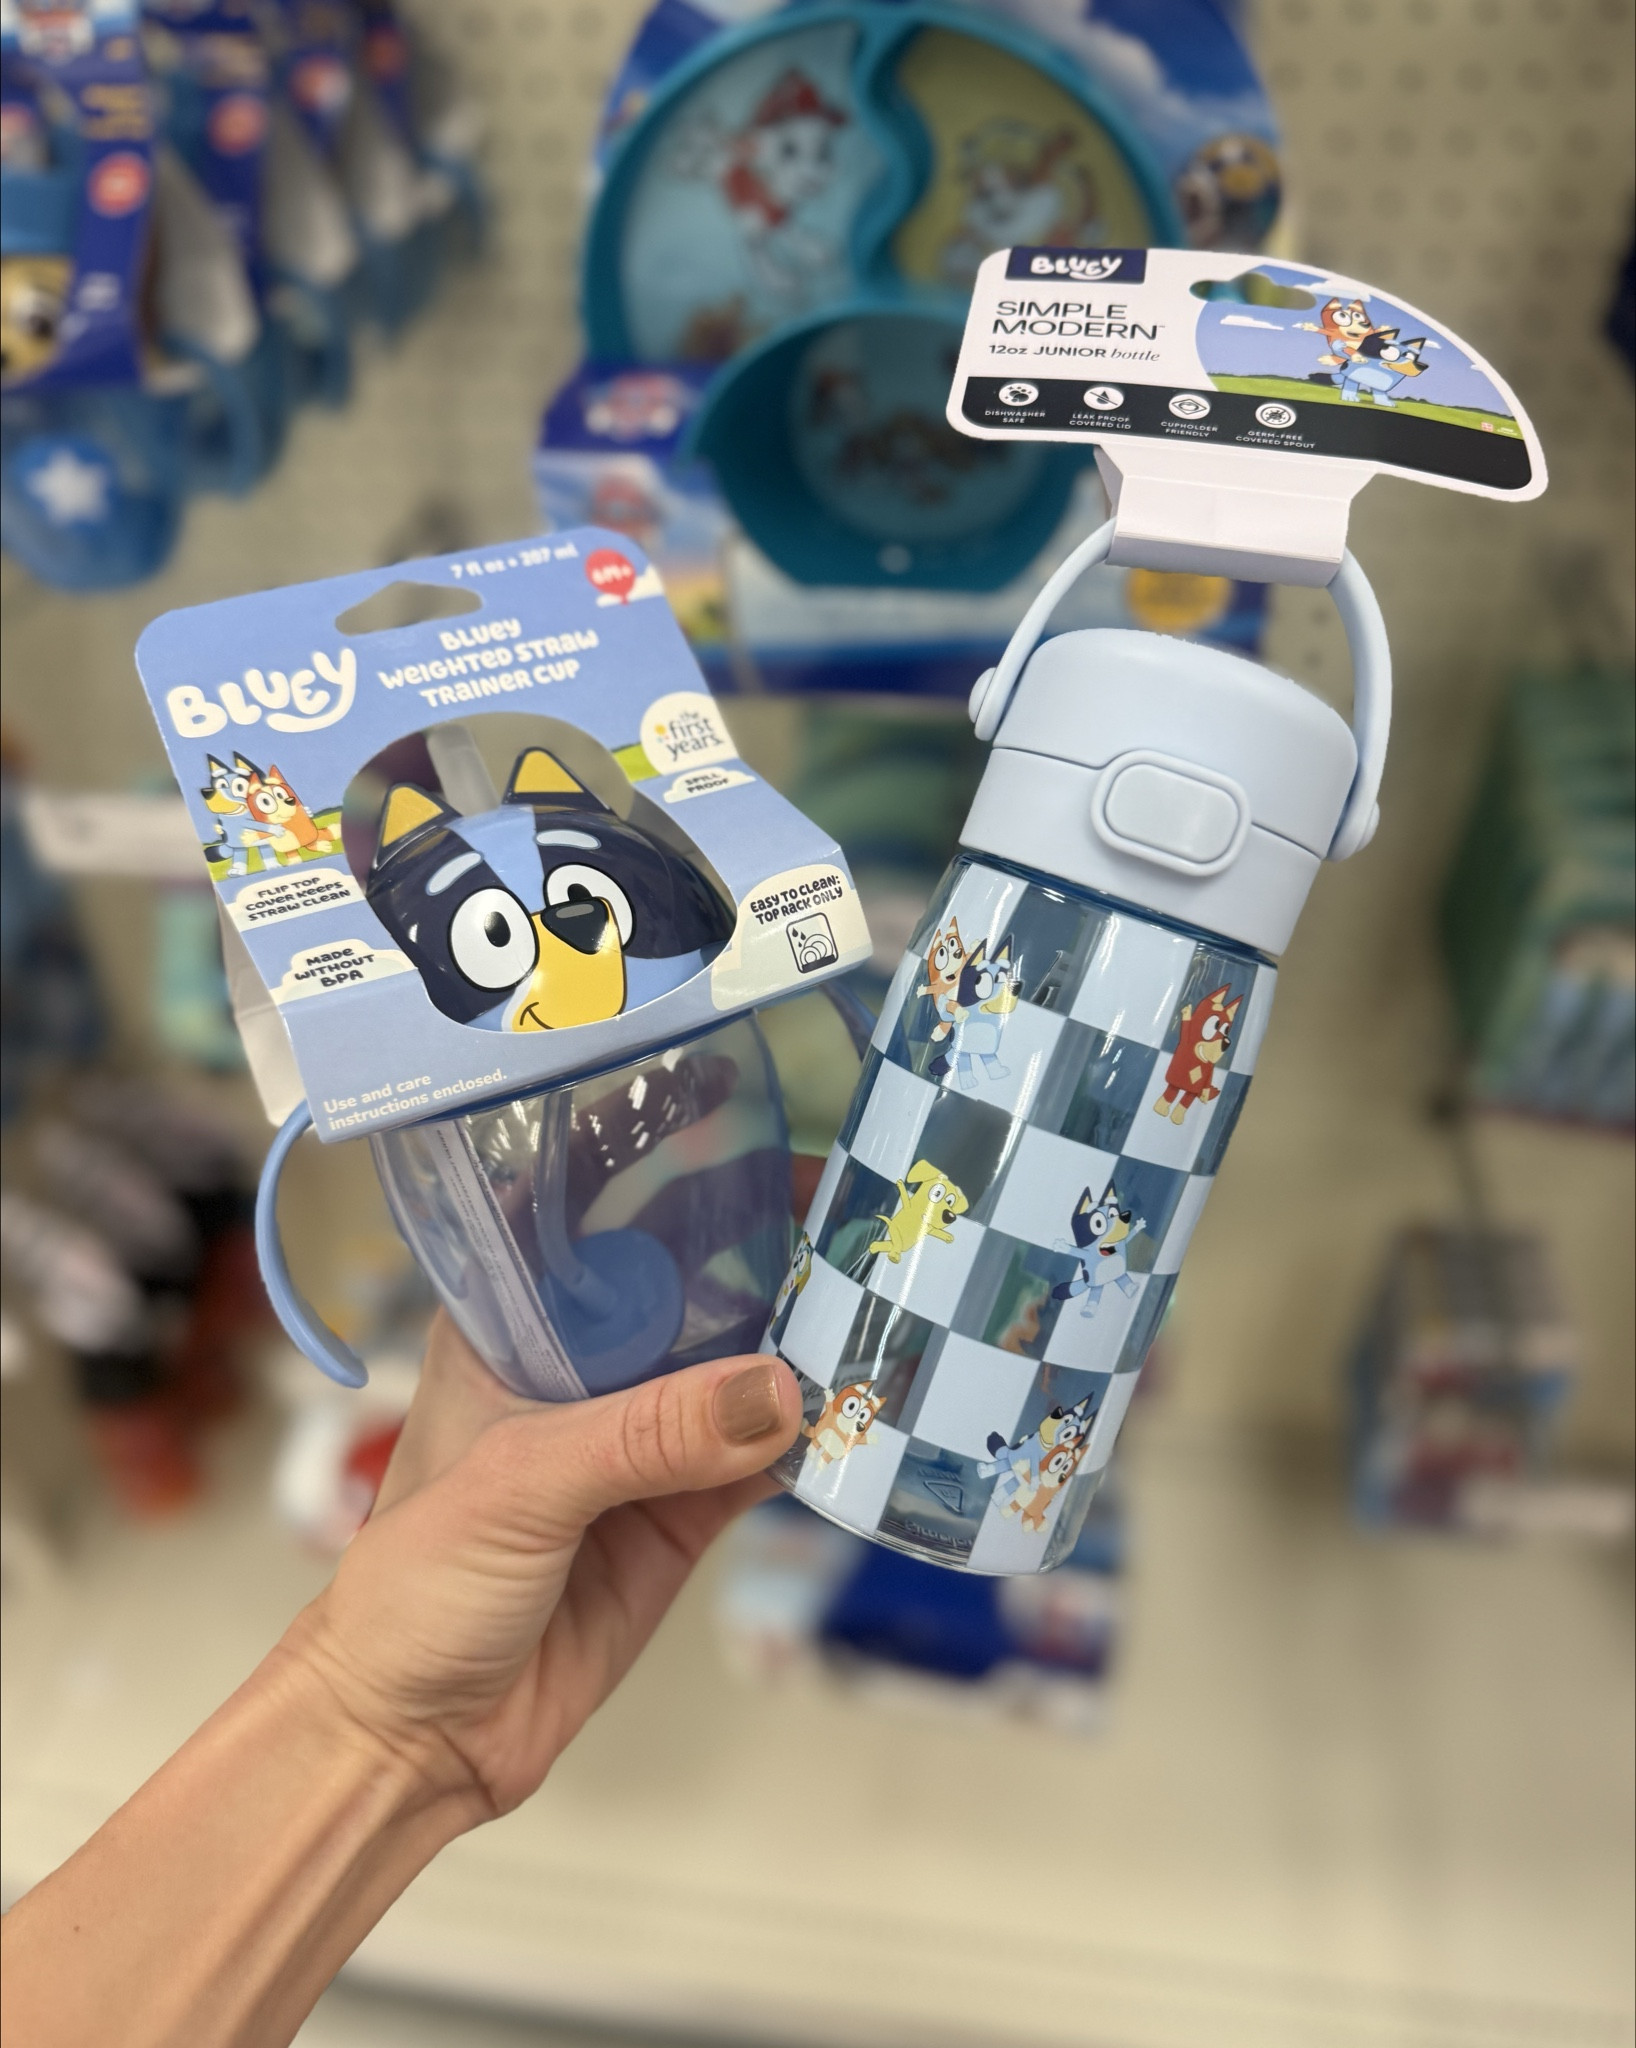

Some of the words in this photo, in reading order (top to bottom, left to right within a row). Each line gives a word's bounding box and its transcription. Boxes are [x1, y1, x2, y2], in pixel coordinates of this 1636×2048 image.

[996, 301, 1128, 320] SIMPLE
[989, 344, 1028, 355] 12oz
[1033, 345, 1107, 358] JUNIOR
[1110, 348, 1161, 362] bottle
[984, 410, 1046, 418] DISHWASHER
[1098, 415, 1130, 423] PROOF
[1069, 420, 1114, 428] COVERED
[1160, 421, 1218, 432] CUPHOLDER
[1165, 429, 1210, 438] FRIENDLY
[1248, 430, 1303, 441] GERM-FREE
[1235, 435, 1281, 446] COVERED
[1283, 440, 1316, 449] SPOUT
[450, 564, 463, 580] 7
[532, 658, 581, 685] CUP
[668, 717, 714, 740] first
[684, 773, 721, 786] SPILL
[686, 778, 729, 793] PROOF
[257, 884, 289, 898] FLIP
[291, 876, 321, 889] TOP
[780, 888, 798, 902] TO
[755, 907, 780, 925] TOP
[812, 886, 843, 906] ONLY
[294, 953, 375, 981] WITHOUT
[319, 968, 364, 987] BPA
[323, 1098, 358, 1114] Use
[360, 1084, 393, 1104] and
[395, 1074, 433, 1093] care
[328, 1092, 430, 1131] instructions
[432, 1067, 508, 1100] enclosed.
